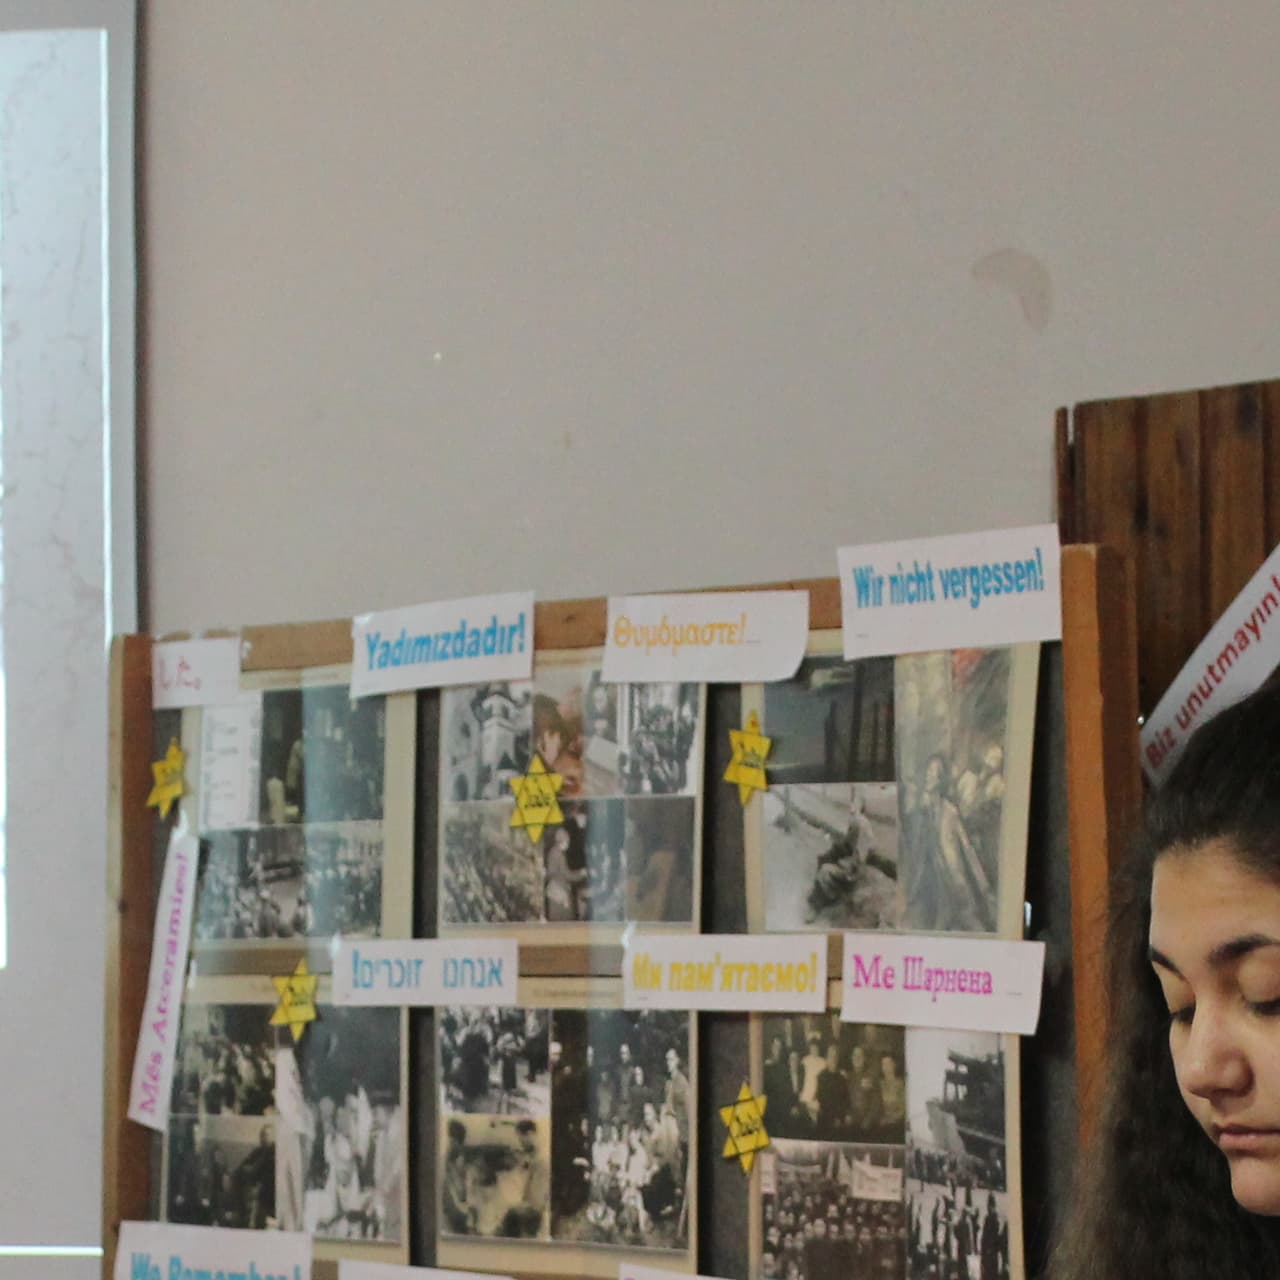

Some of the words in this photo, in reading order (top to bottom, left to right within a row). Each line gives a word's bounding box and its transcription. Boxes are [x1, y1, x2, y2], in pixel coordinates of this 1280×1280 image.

[852, 564, 884, 609] Wir
[889, 560, 936, 606] nicht
[939, 547, 1045, 609] vergessen!
[1146, 727, 1179, 769] Biz
[352, 948, 424, 988] זוכרים!
[442, 957, 504, 988] אנחנו
[632, 952, 663, 990] Ми
